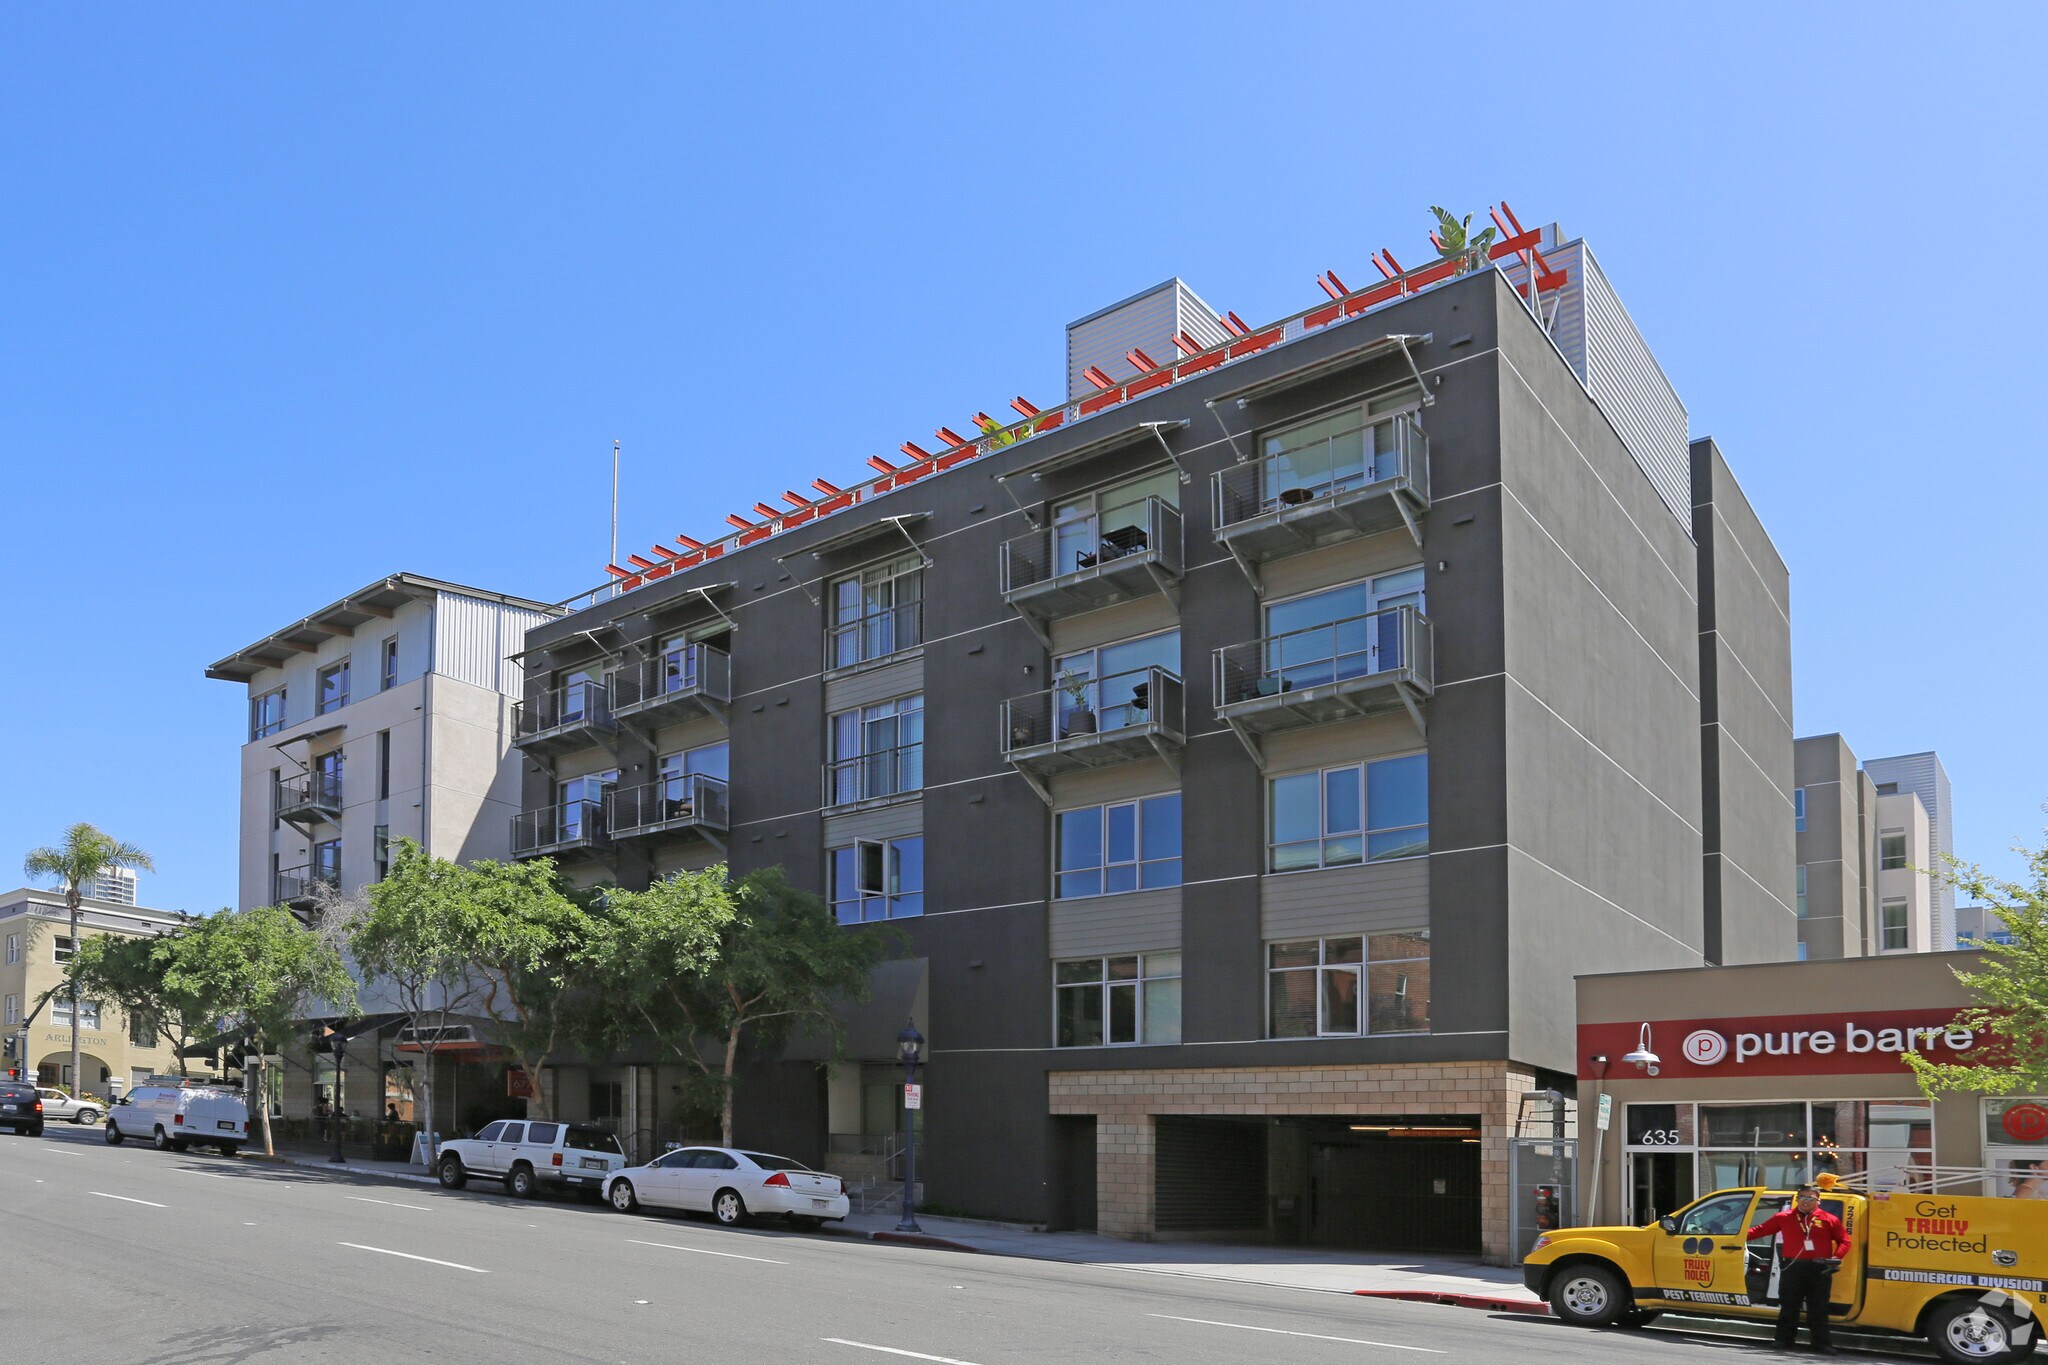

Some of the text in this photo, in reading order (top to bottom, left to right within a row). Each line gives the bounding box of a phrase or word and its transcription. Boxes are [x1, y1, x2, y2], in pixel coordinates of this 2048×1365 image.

[45, 1033, 107, 1046] ARLIGTON
[1735, 1022, 1974, 1063] pure barre
[1642, 1129, 1679, 1145] 635
[1915, 1200, 1957, 1218] Get
[1904, 1217, 1969, 1236] TRULY
[1886, 1231, 1987, 1253] Protected
[1683, 1258, 1711, 1270] TRULY
[1684, 1270, 1710, 1282] NOLEN
[1884, 1269, 2043, 1292] COMMERCIAL DIVISION
